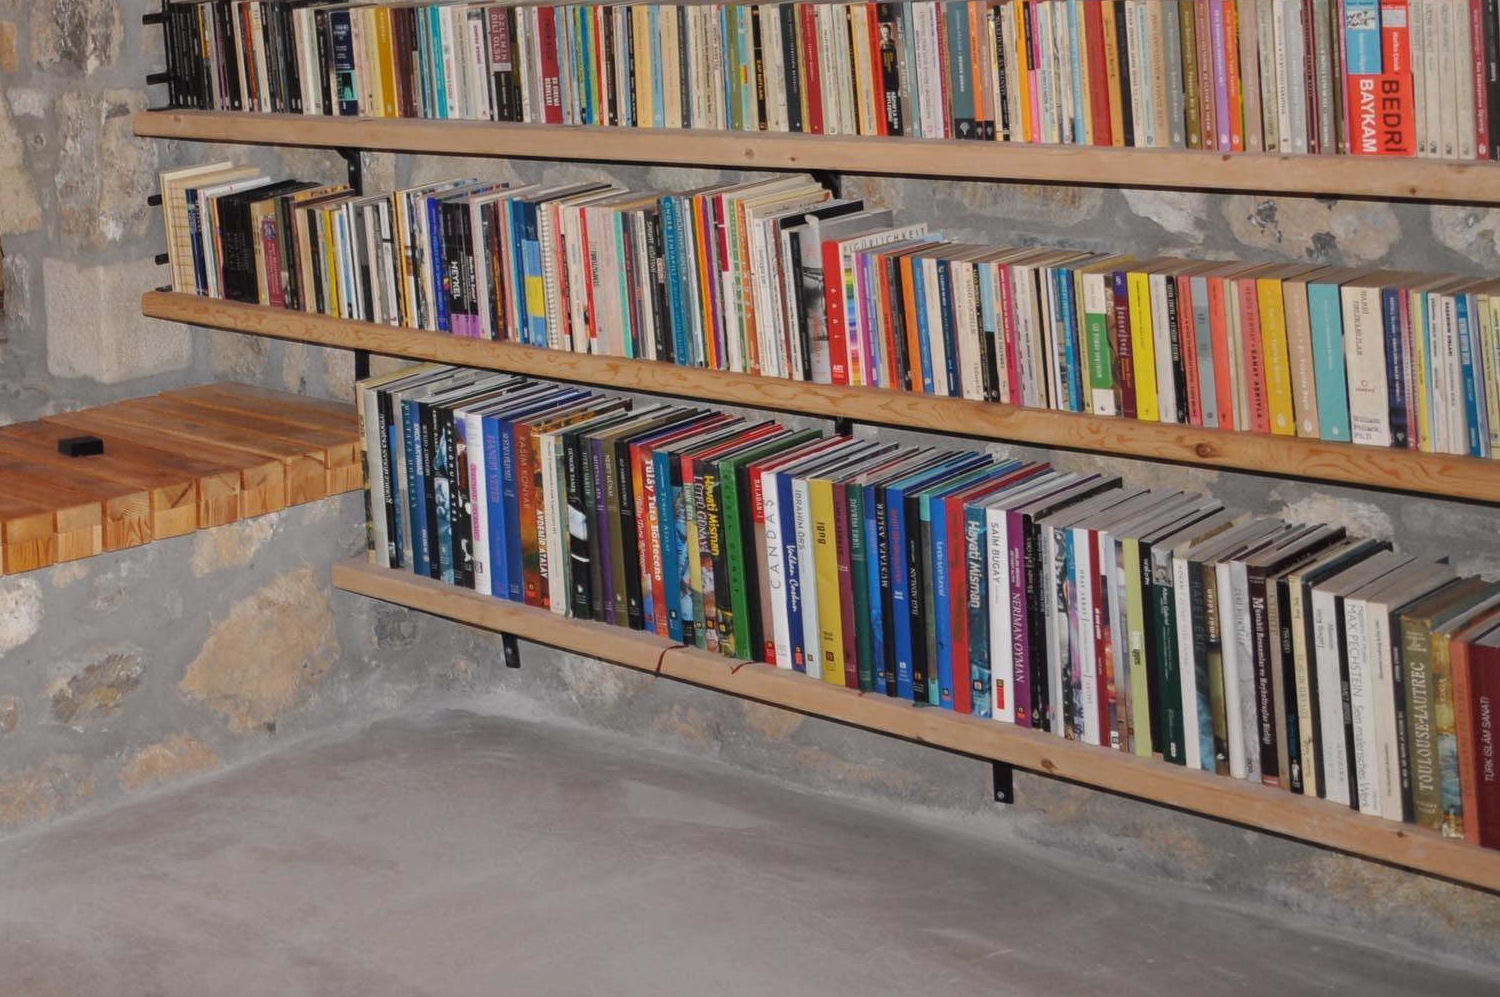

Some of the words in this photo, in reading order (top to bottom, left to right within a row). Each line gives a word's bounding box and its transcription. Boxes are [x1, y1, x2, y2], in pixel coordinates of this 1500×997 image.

[1360, 78, 1377, 152] BAYKAM
[1380, 78, 1406, 153] BEDRİ
[450, 260, 461, 299] HEYKEL
[647, 495, 658, 520] Tura
[704, 474, 717, 510] Hayati
[794, 489, 805, 528] İBRAHİM
[650, 524, 663, 581] Börtecene
[708, 513, 721, 556] Misman
[763, 498, 781, 589] CANDAŞ
[797, 531, 807, 549] ÖRS
[964, 520, 981, 560] Hayati
[990, 522, 1000, 546] SAİM
[537, 547, 548, 578] ATALAY
[877, 542, 890, 587] MUSTAFA
[990, 549, 1001, 583] BUGAY
[967, 562, 982, 608] Misman
[1010, 591, 1024, 641] NERİMAN
[1345, 603, 1357, 629] MAX
[1012, 642, 1025, 682] OYMAN
[1256, 632, 1267, 668] Ressamlar
[1348, 634, 1362, 697] PECHSTEIN
[1353, 705, 1364, 723] Sein
[1409, 659, 1434, 791] TOULOUSE-LAUTREC
[1479, 696, 1491, 728] SANATI
[1354, 726, 1368, 780] malerisches
[1358, 781, 1370, 807] Werk
